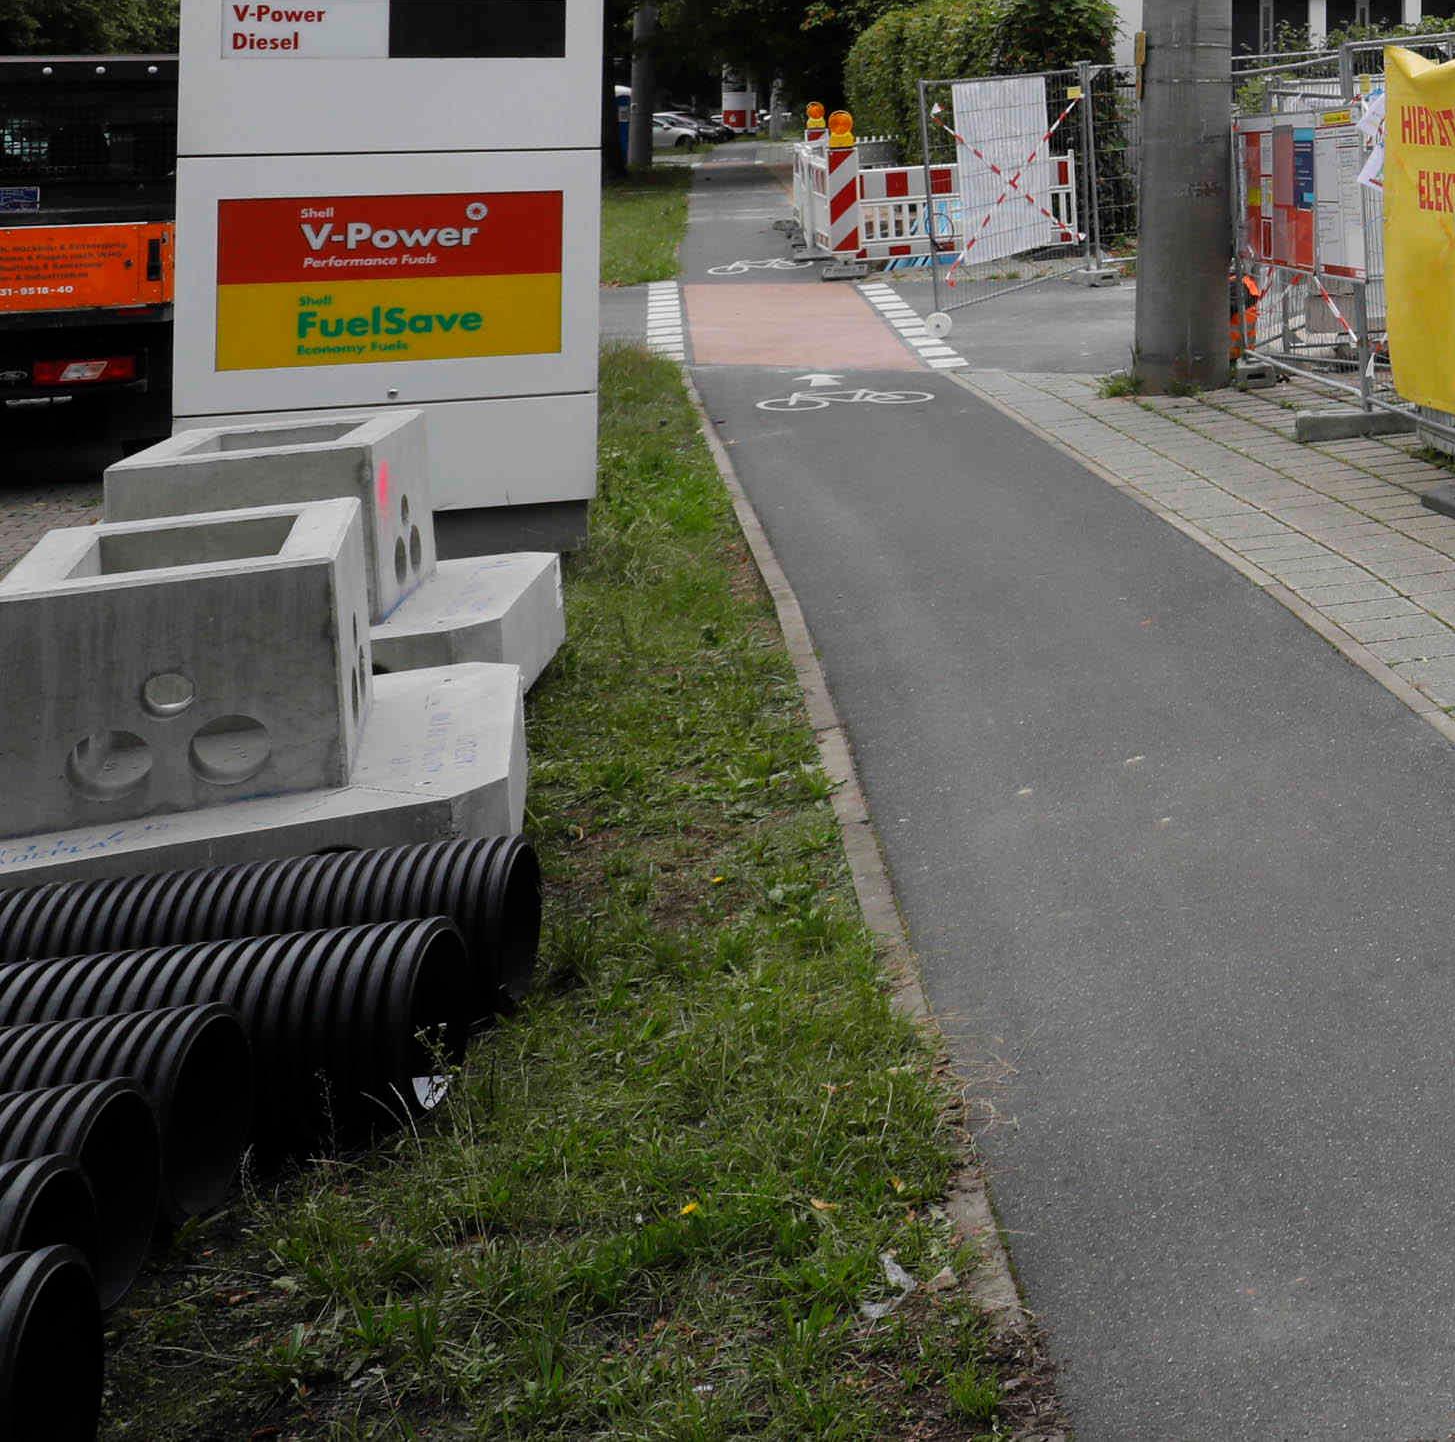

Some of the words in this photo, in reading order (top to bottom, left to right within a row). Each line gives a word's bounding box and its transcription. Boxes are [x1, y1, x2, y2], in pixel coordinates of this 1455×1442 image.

[233, 4, 326, 23] V-Power
[232, 32, 300, 51] Diesel
[1401, 106, 1434, 146] HIER
[301, 207, 334, 219] Shell
[300, 222, 479, 250] V-Power
[303, 256, 397, 268] Performance
[401, 253, 437, 265] Fuels
[297, 306, 483, 338] FuelSave
